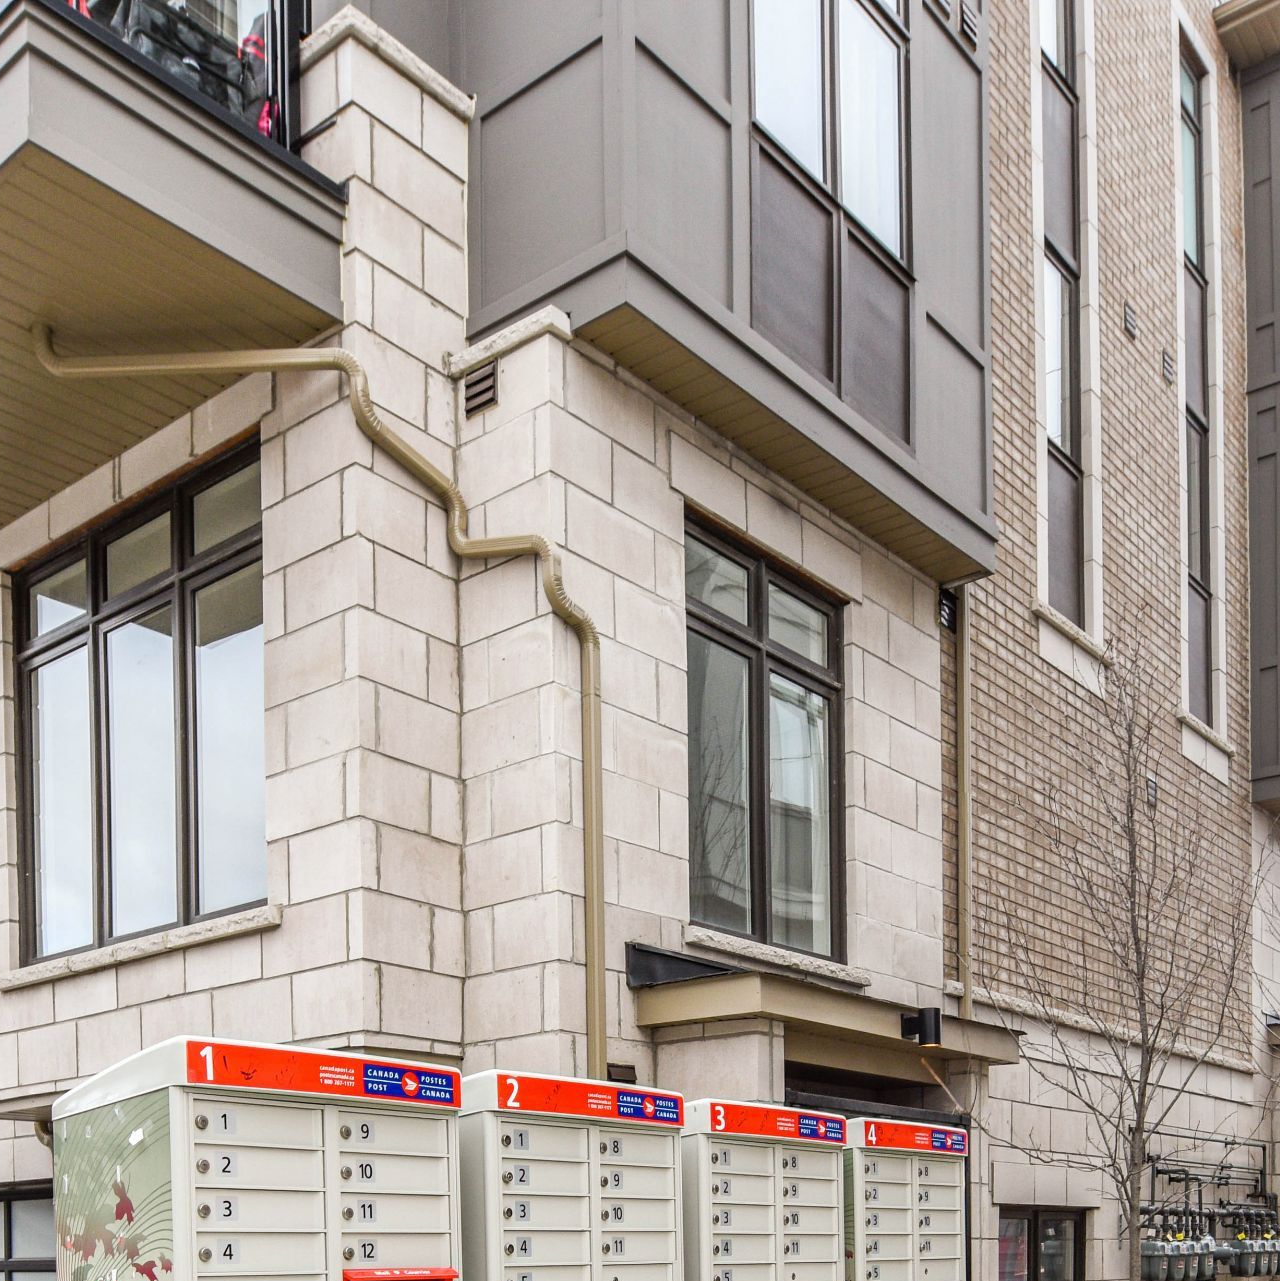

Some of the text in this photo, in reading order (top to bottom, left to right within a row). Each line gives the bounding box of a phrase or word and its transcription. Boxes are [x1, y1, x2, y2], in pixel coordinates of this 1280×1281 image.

[200, 1046, 213, 1080] 1
[368, 1069, 399, 1079] CANADA
[421, 1076, 446, 1086] POSTES
[368, 1083, 388, 1092] POST
[506, 1079, 520, 1108] 2
[422, 1089, 450, 1099] CANADA
[620, 1096, 642, 1104] CANADA
[222, 1114, 227, 1129] 1
[715, 1106, 726, 1130] 3
[361, 1124, 369, 1139] 9
[868, 1124, 876, 1145] 4
[519, 1133, 523, 1146] 1
[613, 1141, 619, 1153] 8
[724, 1152, 726, 1162] 1
[792, 1157, 796, 1167] 8
[222, 1157, 230, 1173] 2
[359, 1164, 372, 1178] 10
[519, 1169, 525, 1182] 2
[614, 1174, 619, 1186] 9
[724, 1182, 728, 1193] 2
[792, 1185, 796, 1196] 9
[223, 1201, 231, 1216] 3
[361, 1204, 372, 1218] 11
[520, 1205, 526, 1217] 3
[613, 1207, 622, 1220] 10
[724, 1212, 728, 1223] 3
[791, 1214, 798, 1224] 10
[223, 1244, 233, 1259] 4
[362, 1244, 374, 1258] 12
[521, 1240, 527, 1253] 4
[615, 1240, 622, 1252] 11
[724, 1242, 729, 1253] 4
[792, 1242, 798, 1252] 11
